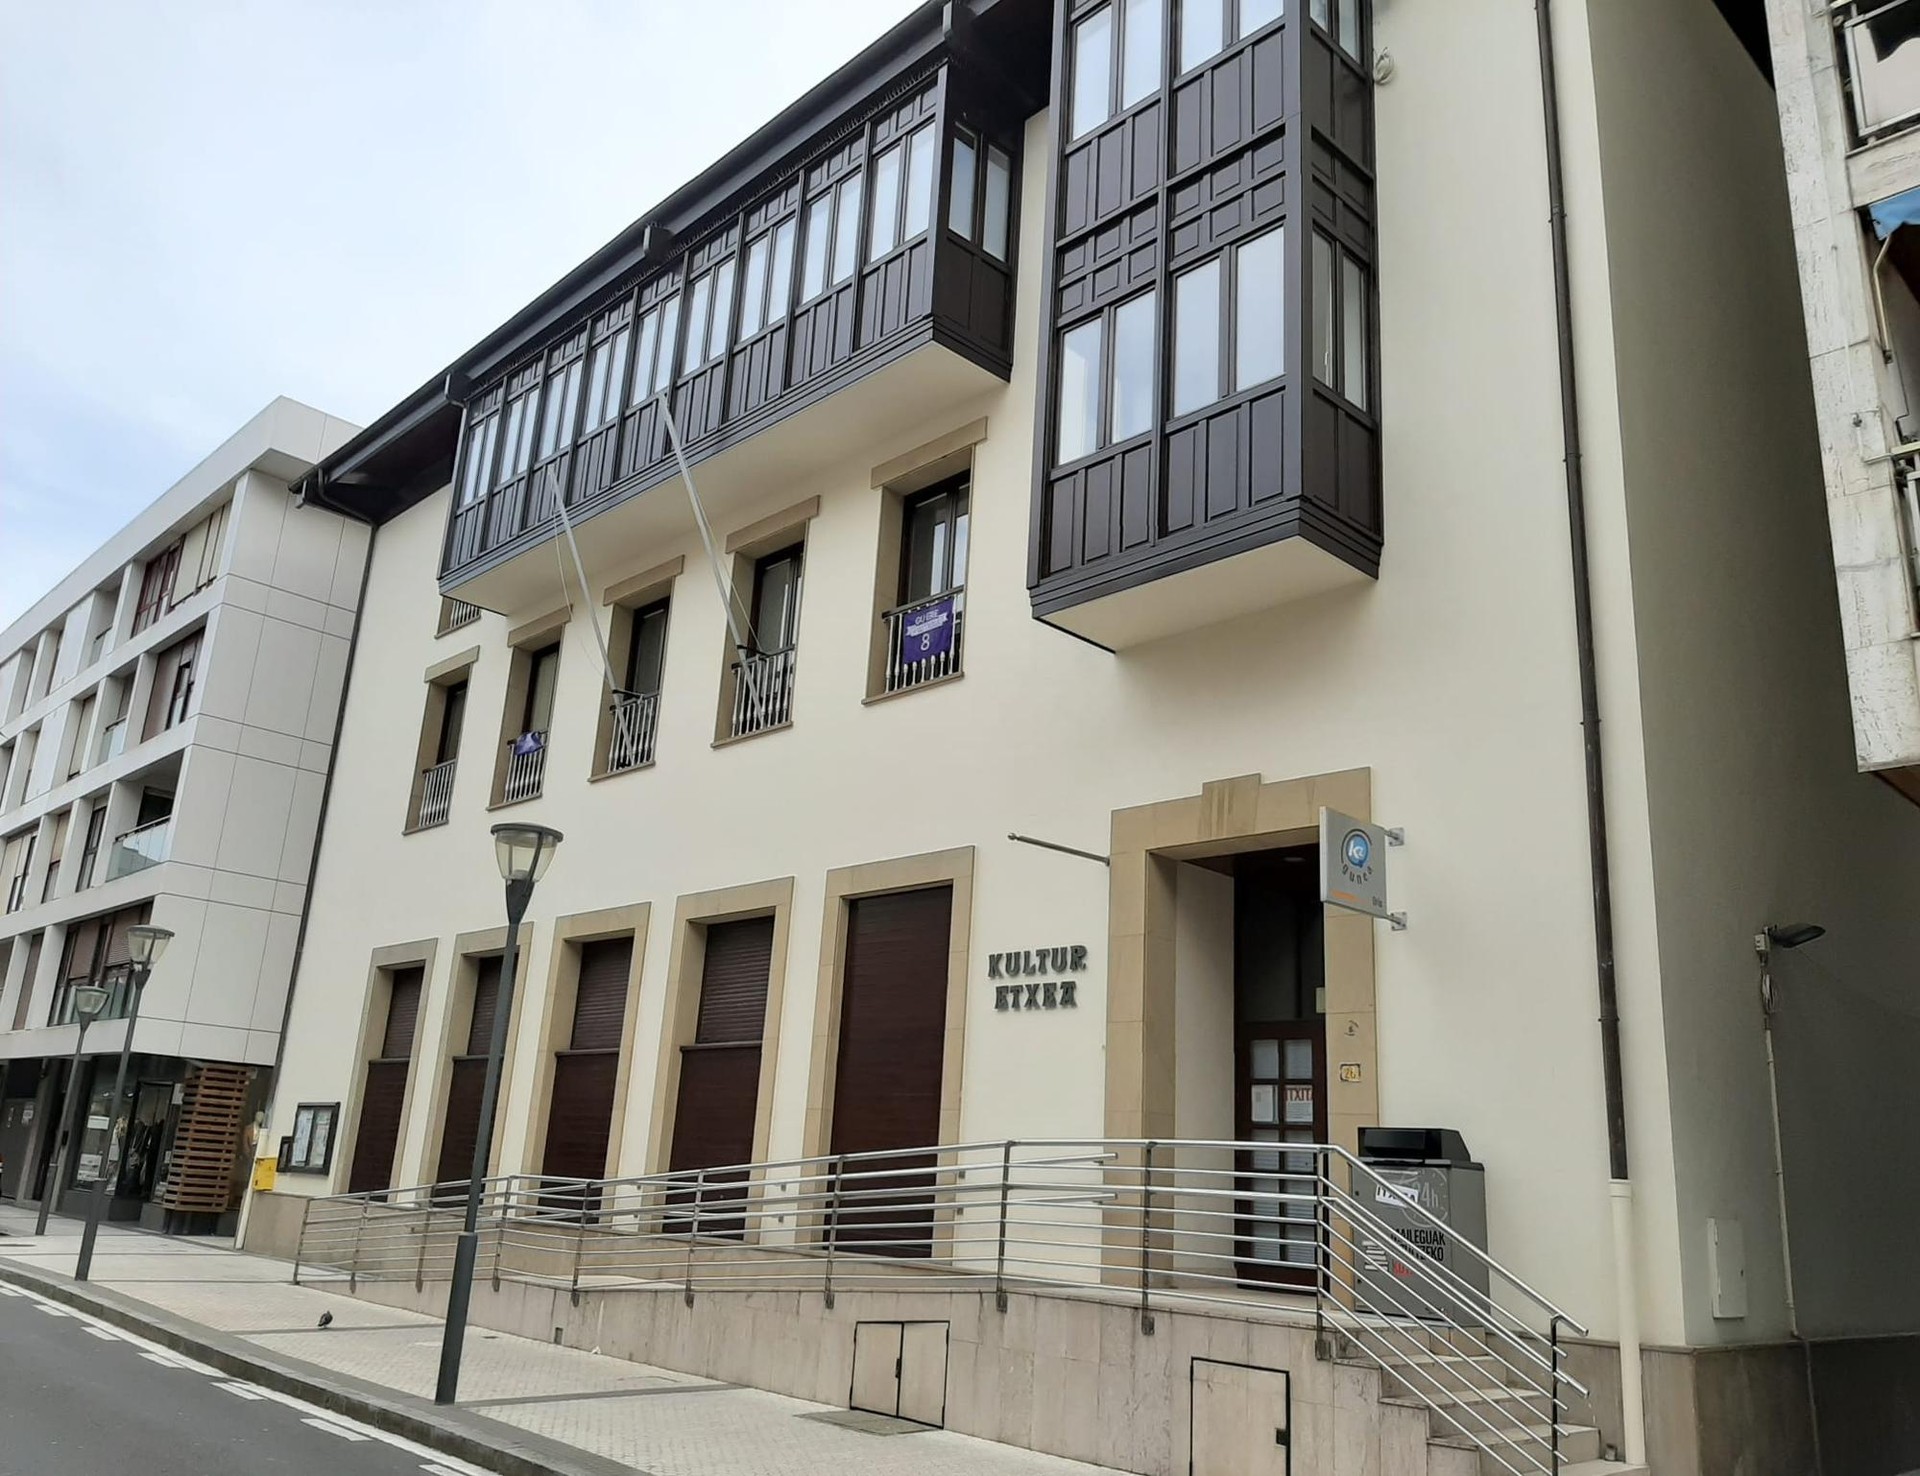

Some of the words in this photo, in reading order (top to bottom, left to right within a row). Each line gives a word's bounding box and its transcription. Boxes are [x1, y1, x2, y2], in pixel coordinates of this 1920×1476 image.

[920, 632, 930, 651] 8
[988, 945, 1087, 979] KULTUR
[994, 981, 1077, 1011] ETXEA
